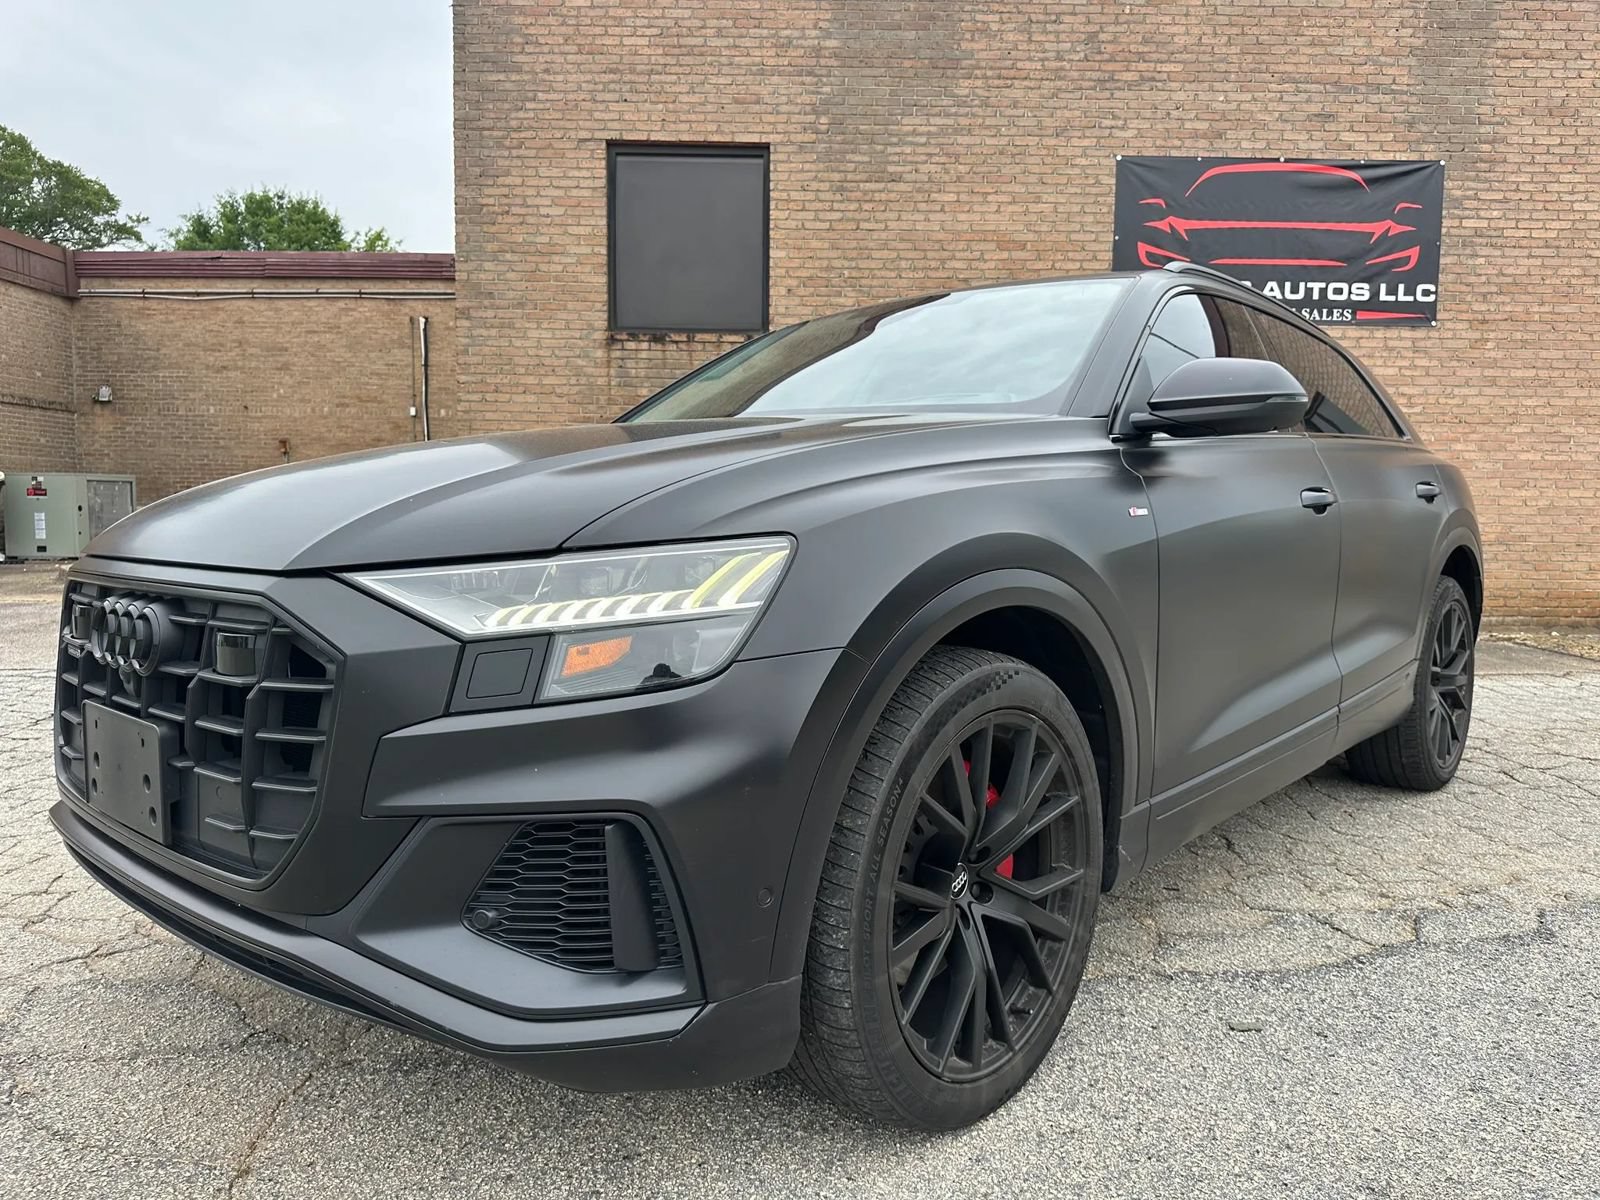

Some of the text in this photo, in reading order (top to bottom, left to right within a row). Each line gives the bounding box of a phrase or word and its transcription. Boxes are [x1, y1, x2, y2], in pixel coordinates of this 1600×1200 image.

[1263, 281, 1370, 301] AUTOS
[1379, 283, 1436, 302] LLC
[1301, 308, 1352, 321] SALES
[863, 888, 874, 940] SPORT
[869, 853, 881, 882] ALL
